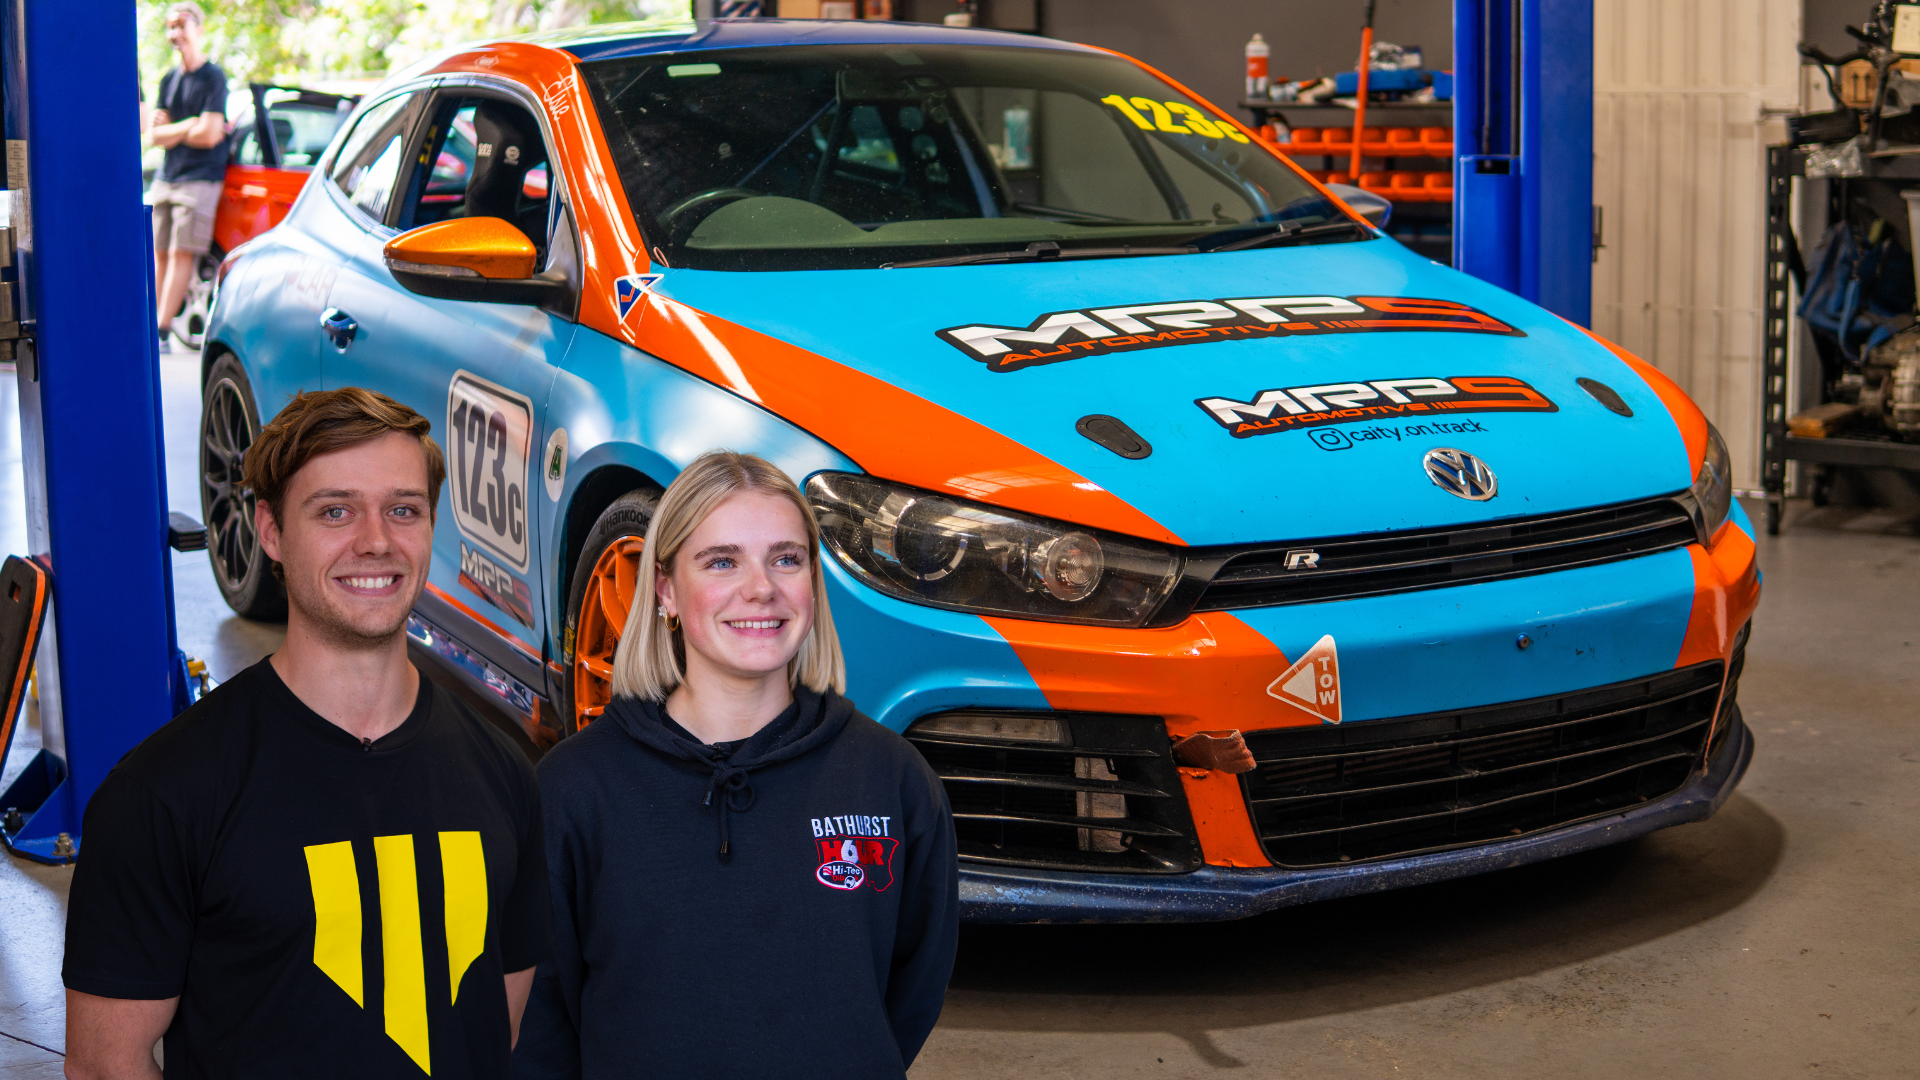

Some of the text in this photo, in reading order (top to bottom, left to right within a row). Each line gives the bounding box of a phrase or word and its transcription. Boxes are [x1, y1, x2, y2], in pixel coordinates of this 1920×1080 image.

[948, 296, 1512, 356] MRPS
[999, 322, 1319, 366] AUTOMOTIVE
[1201, 377, 1550, 424] MRPS
[1236, 403, 1430, 433] AUTOMOTIVE
[1350, 418, 1489, 441] caity.on.track
[1284, 549, 1320, 570] R
[1318, 656, 1336, 705] TOW
[811, 815, 890, 837] BATHURST
[833, 865, 860, 876] Hi-Tec
